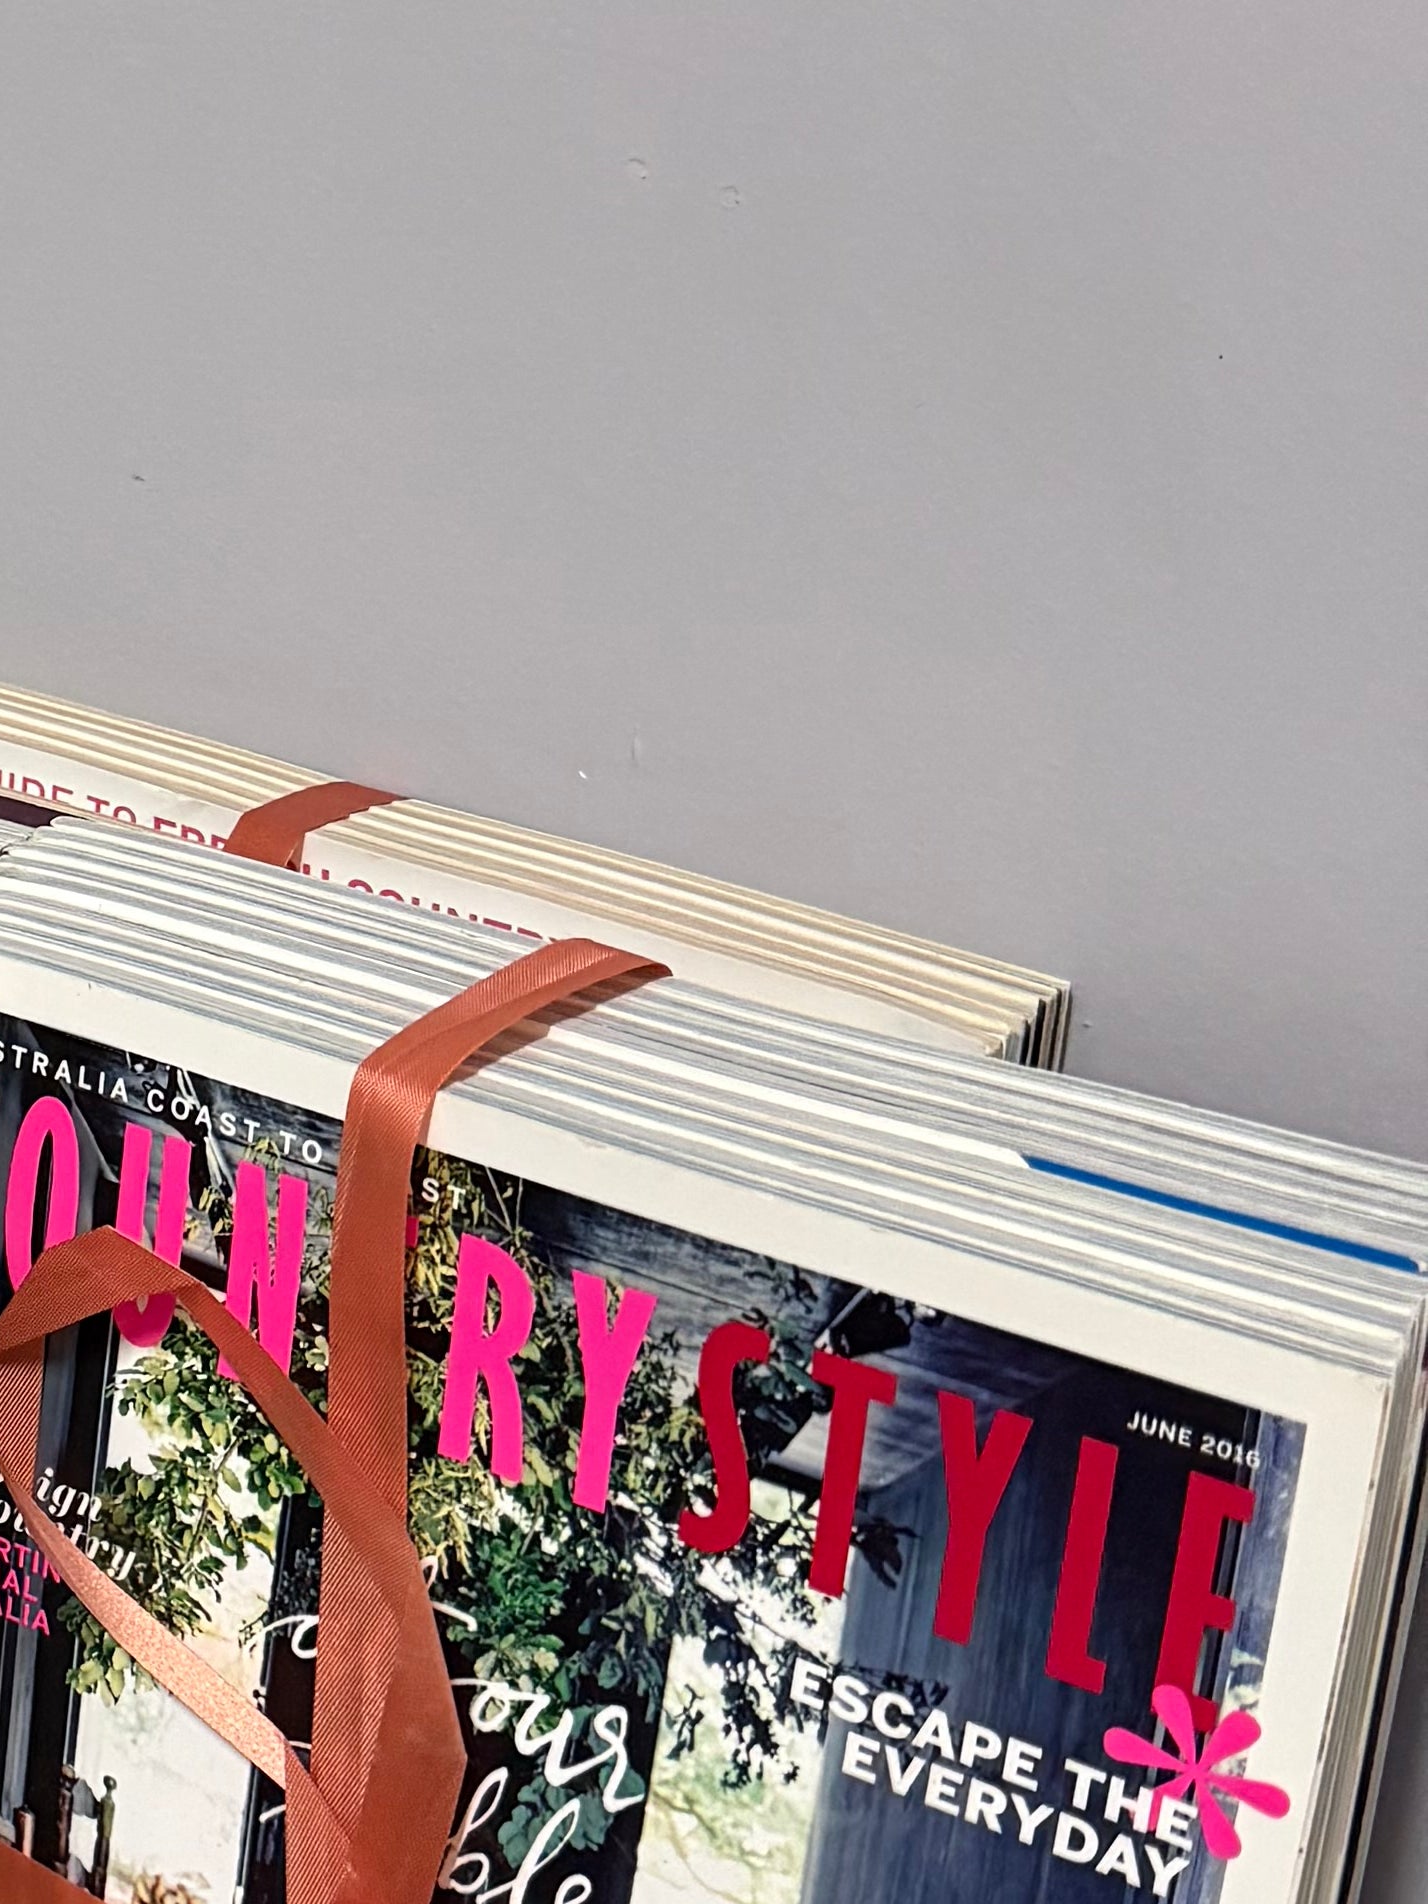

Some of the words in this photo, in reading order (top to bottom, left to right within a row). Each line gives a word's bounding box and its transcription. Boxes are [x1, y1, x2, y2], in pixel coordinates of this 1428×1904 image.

[147, 1086, 261, 1143] COAST
[280, 1130, 324, 1164] TO
[4, 1095, 659, 1514] OUNRY
[677, 1319, 1257, 1734] STYLE
[1127, 1409, 1193, 1452] JUNE
[1200, 1430, 1261, 1473] 2016
[789, 1656, 1043, 1793] ESCAPE
[1061, 1757, 1198, 1854] THE
[841, 1731, 1191, 1898] EVERYDAY
